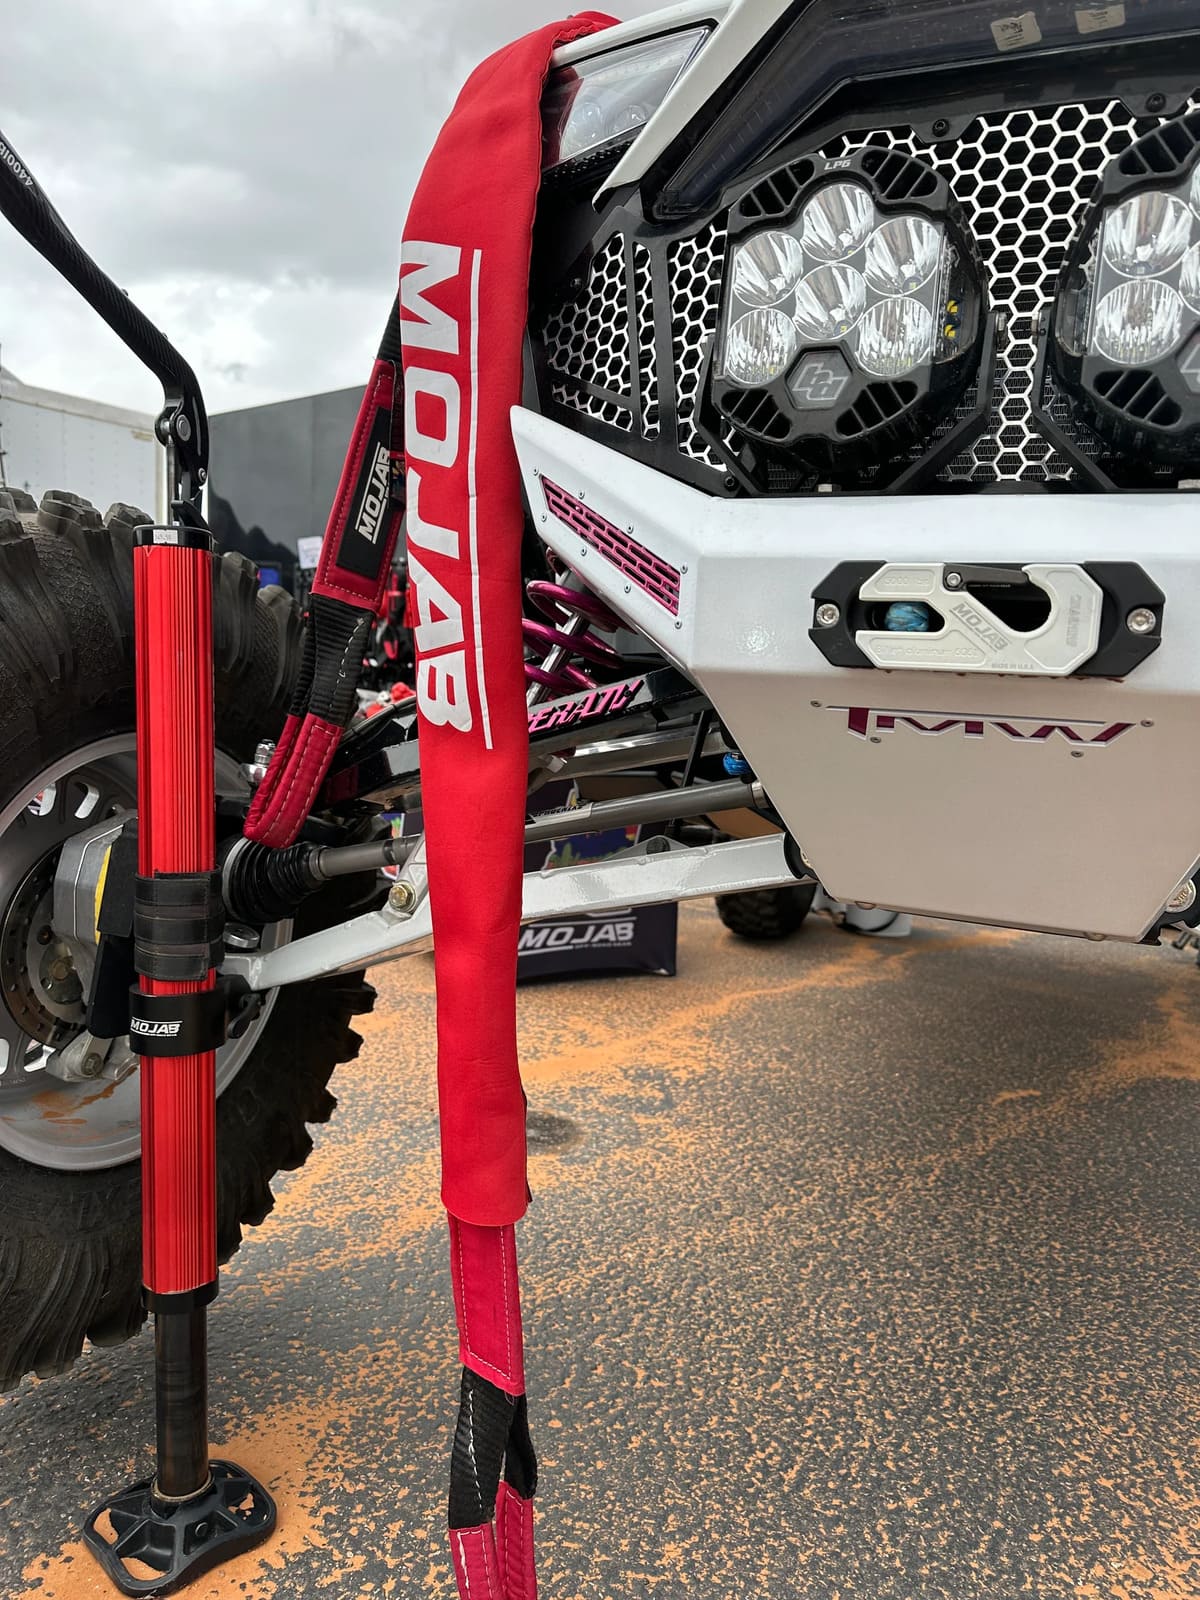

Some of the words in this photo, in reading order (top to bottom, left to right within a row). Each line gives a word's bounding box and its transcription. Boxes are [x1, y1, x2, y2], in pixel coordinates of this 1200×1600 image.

[400, 240, 473, 733] MOJAB
[952, 602, 1009, 650] MOJAB
[517, 922, 635, 950] MOJAB
[130, 1019, 180, 1034] MOJAB
